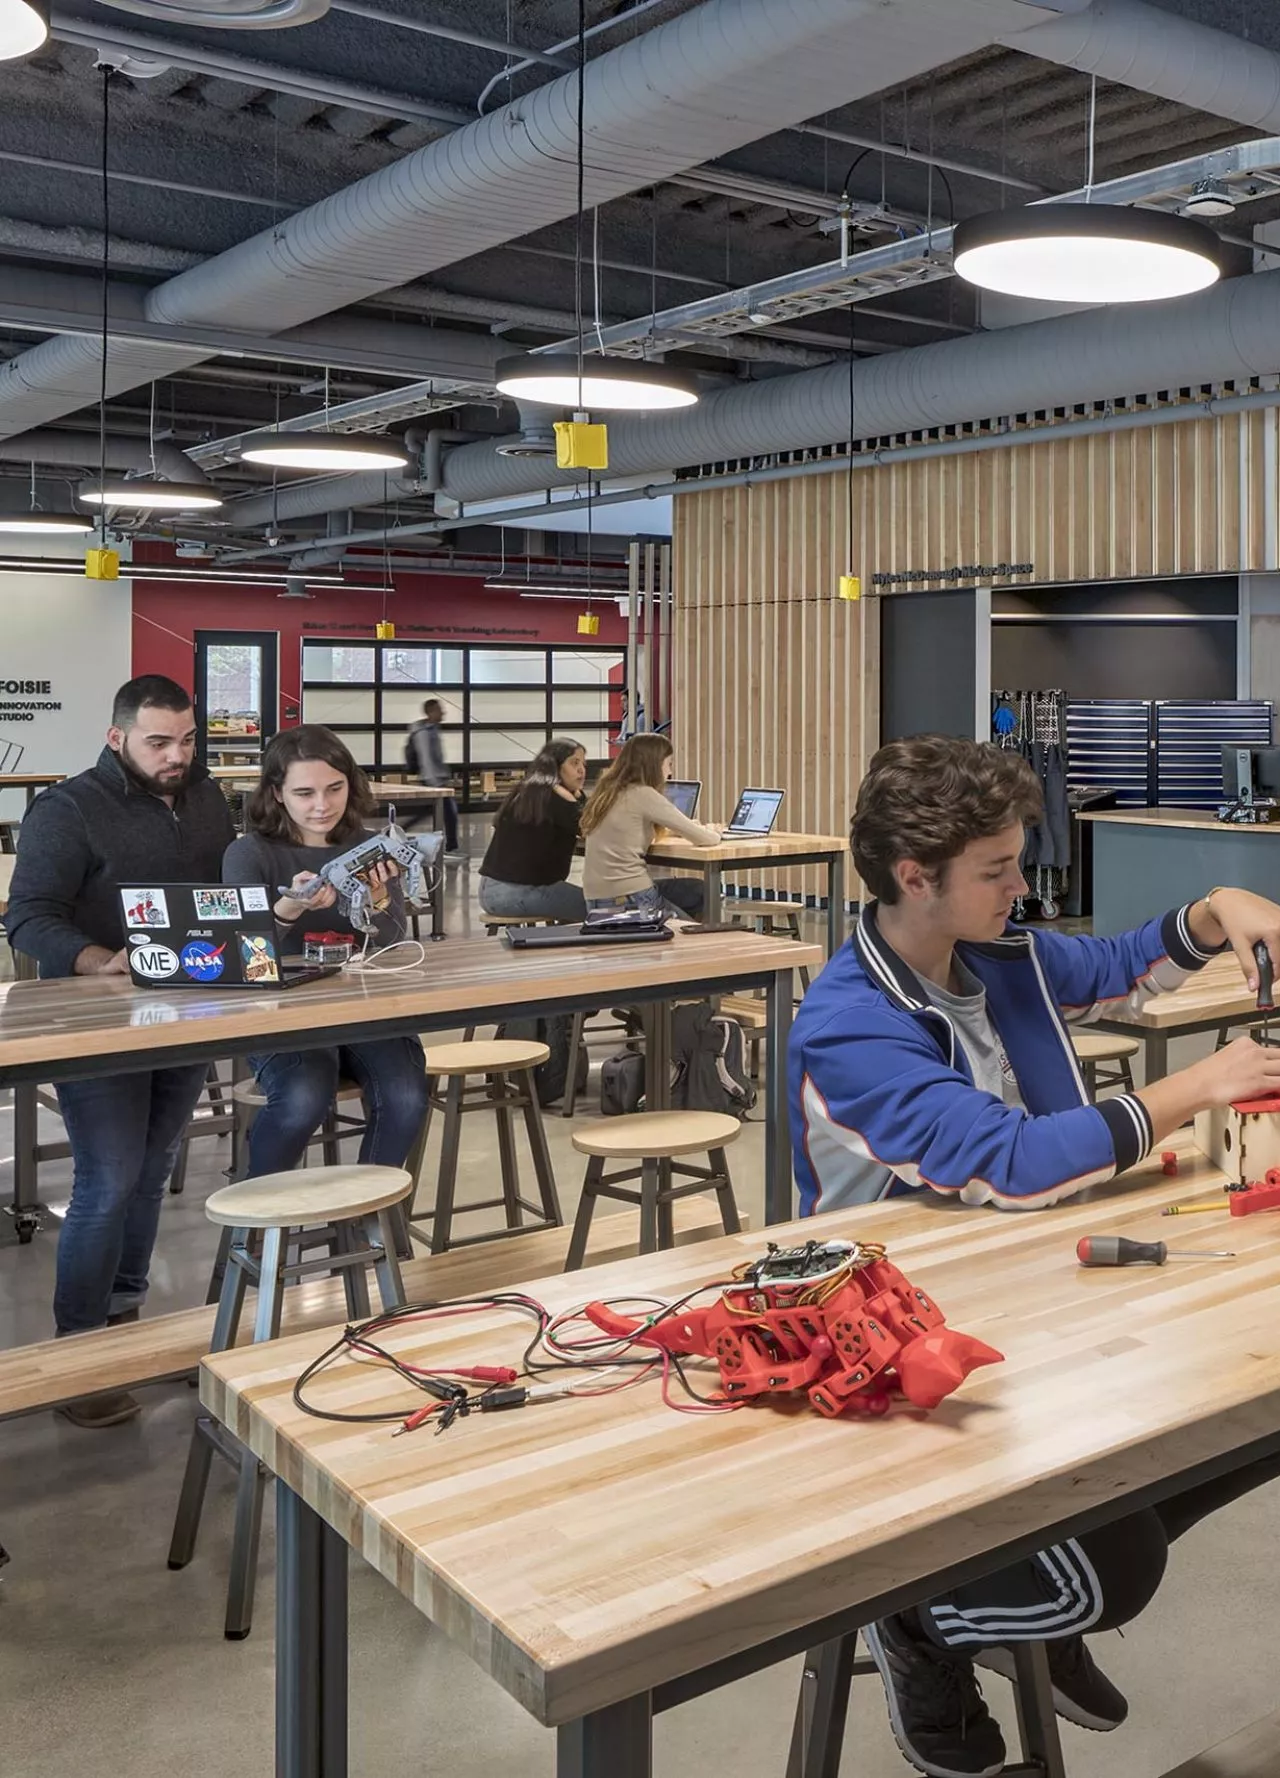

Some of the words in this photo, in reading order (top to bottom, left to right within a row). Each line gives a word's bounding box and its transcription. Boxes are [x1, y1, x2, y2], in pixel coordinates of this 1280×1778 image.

[0, 702, 62, 710] NNOVATION
[186, 929, 213, 937] ASUS
[138, 951, 171, 971] ME
[184, 956, 222, 967] NASA
